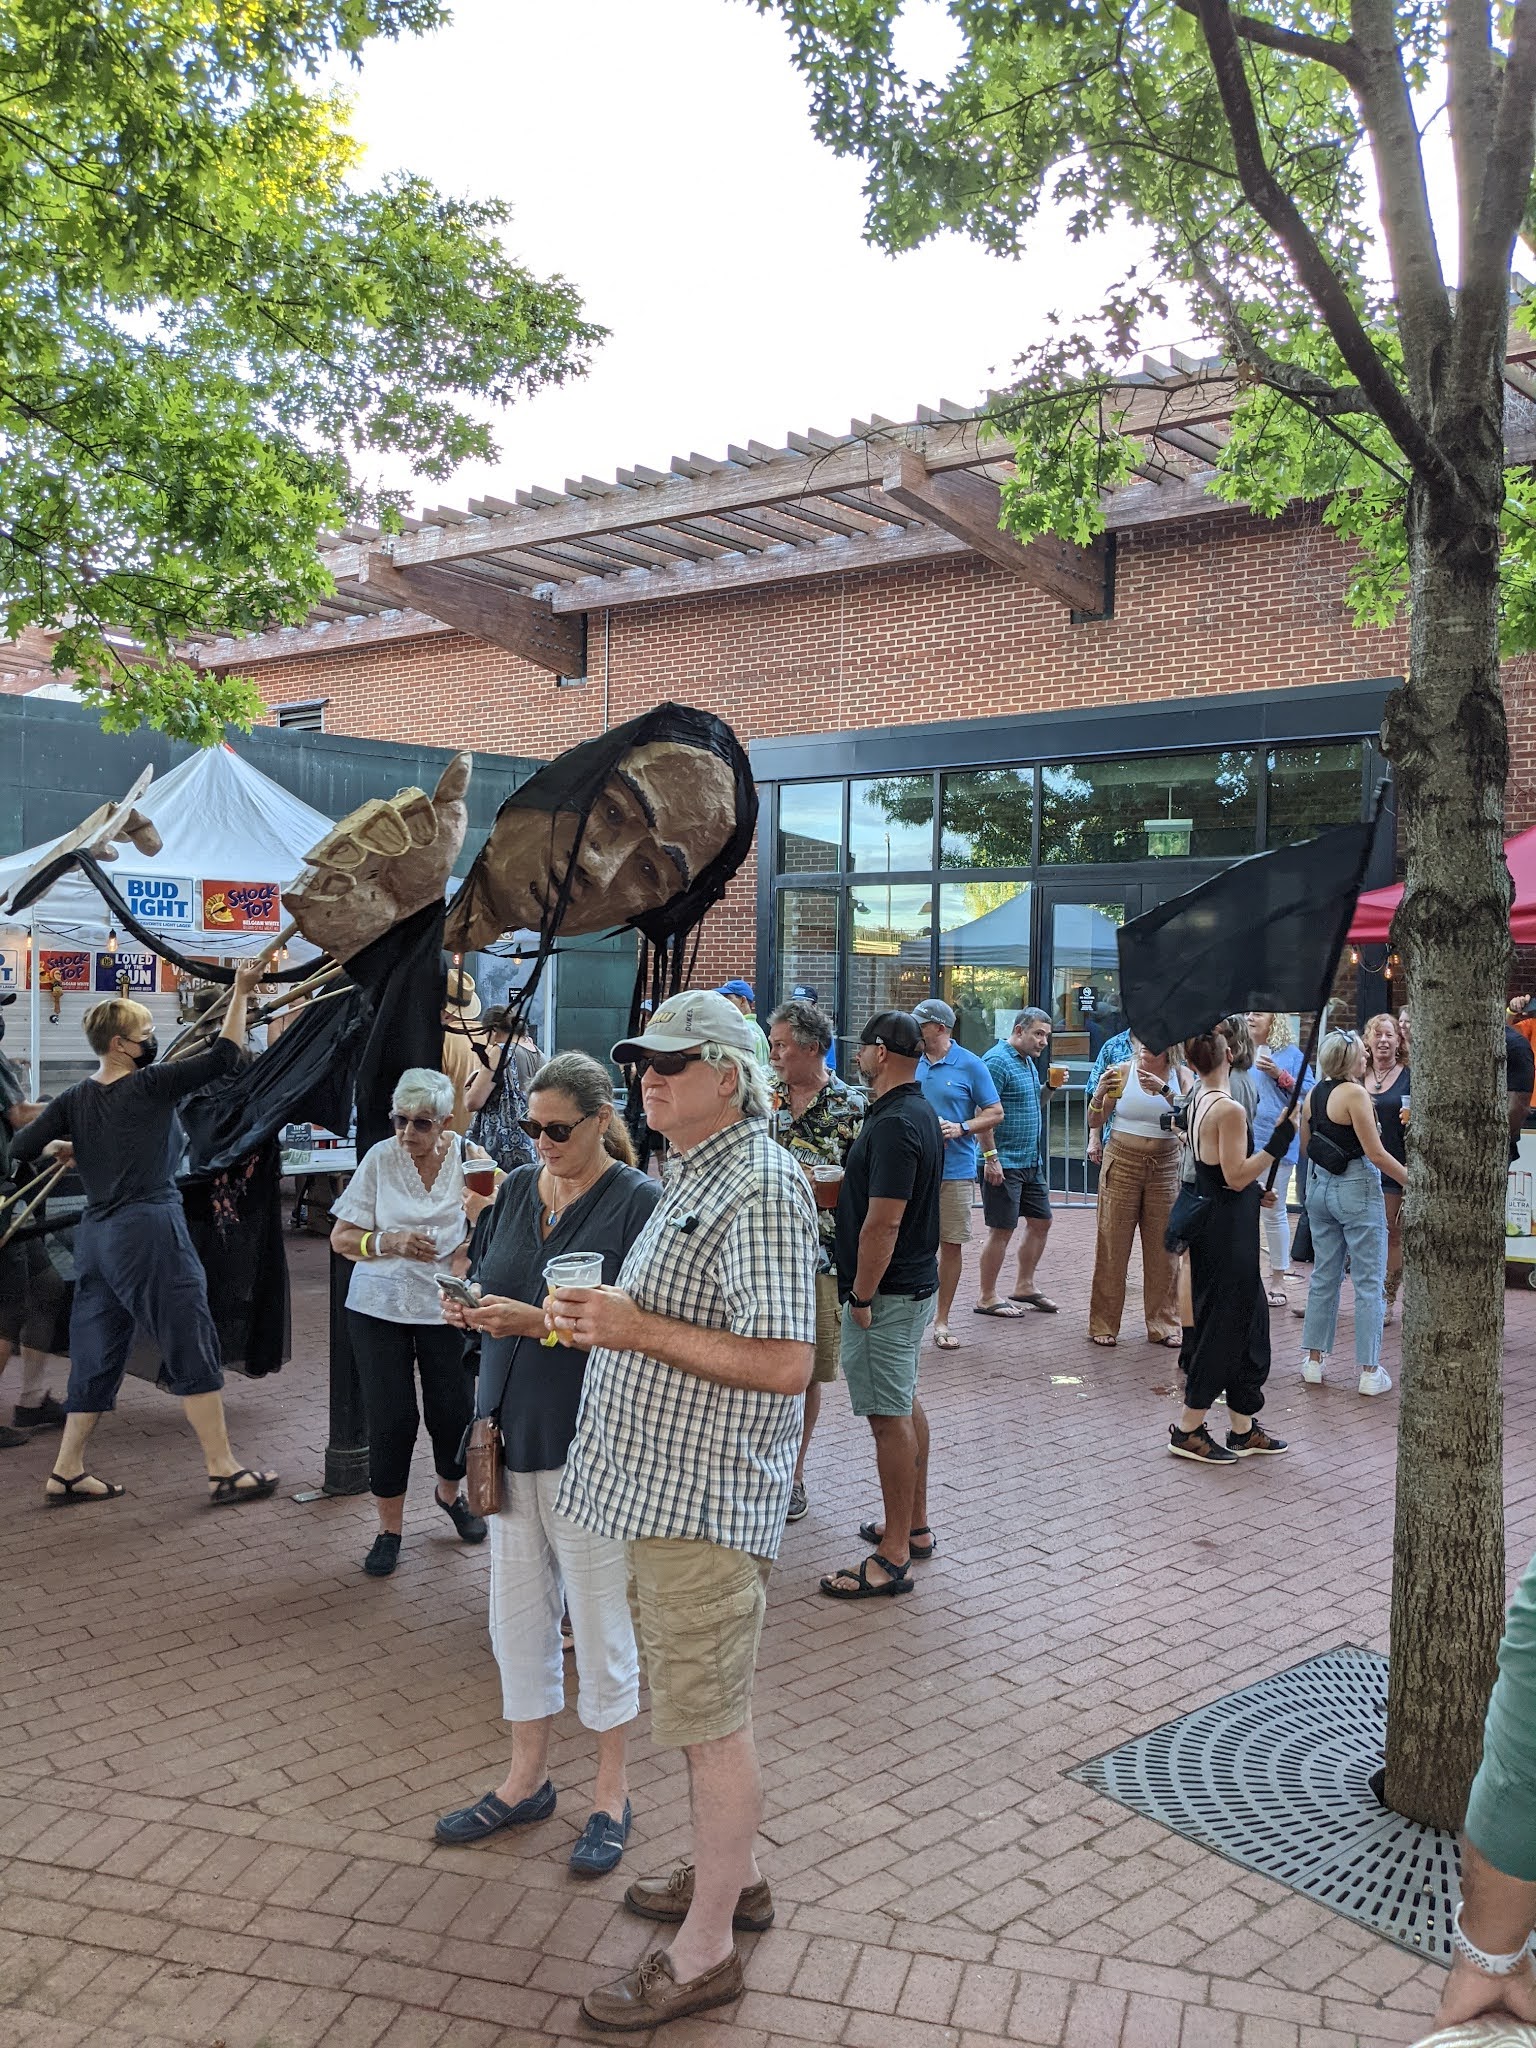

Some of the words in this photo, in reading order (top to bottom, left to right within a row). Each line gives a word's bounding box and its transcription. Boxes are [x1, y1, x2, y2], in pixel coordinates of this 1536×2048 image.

[128, 879, 179, 899] BUD
[227, 884, 280, 908] SHOCK
[113, 898, 188, 918] IGHT
[241, 901, 274, 921] TOP
[47, 953, 90, 971] SHOCK
[115, 954, 154, 965] LOVED
[60, 965, 85, 981] TOP
[115, 969, 152, 985] SUN
